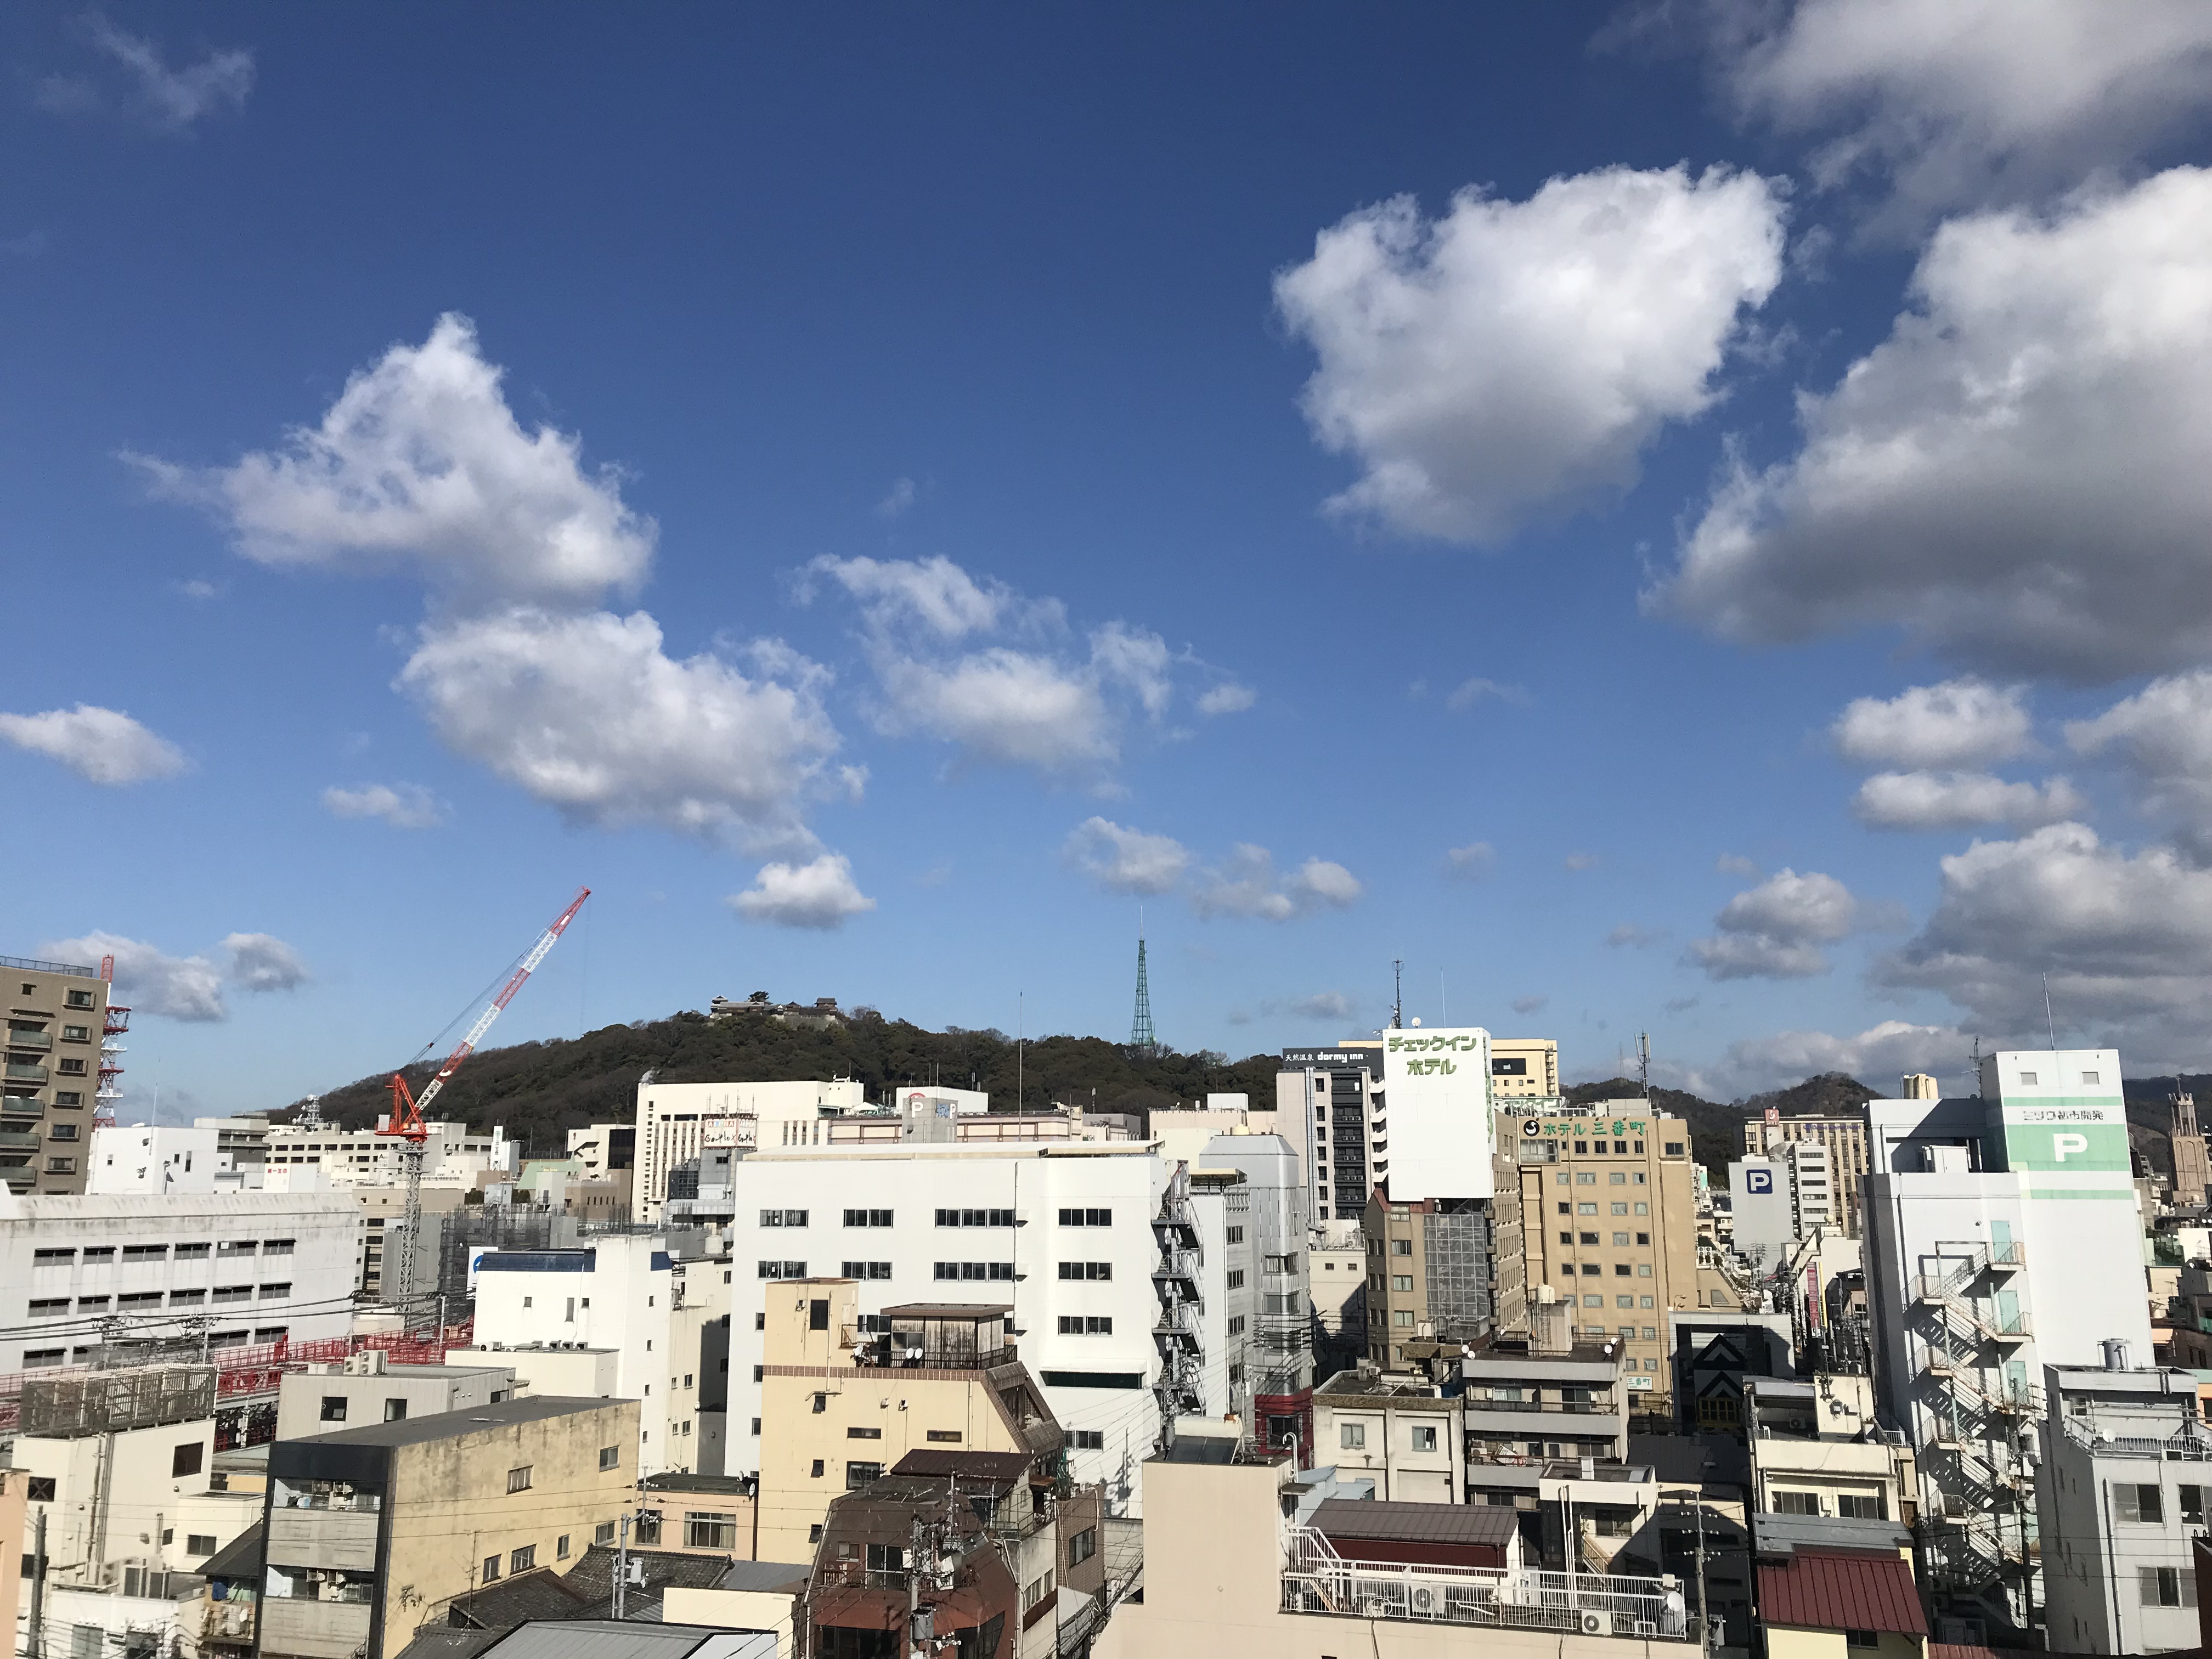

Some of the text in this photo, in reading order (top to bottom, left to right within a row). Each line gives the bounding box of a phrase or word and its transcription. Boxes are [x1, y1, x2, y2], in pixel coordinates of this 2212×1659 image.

[1389, 1035, 1477, 1052] チェックイン
[1285, 1053, 1314, 1062] 天然温泉
[1317, 1051, 1347, 1063] dormy
[1407, 1058, 1457, 1075] ホテル
[911, 1101, 924, 1119] P
[950, 1103, 956, 1119] P
[1543, 1119, 1646, 1137] ホテル三番町
[2053, 1133, 2088, 1162] P
[1750, 1172, 1770, 1191] P
